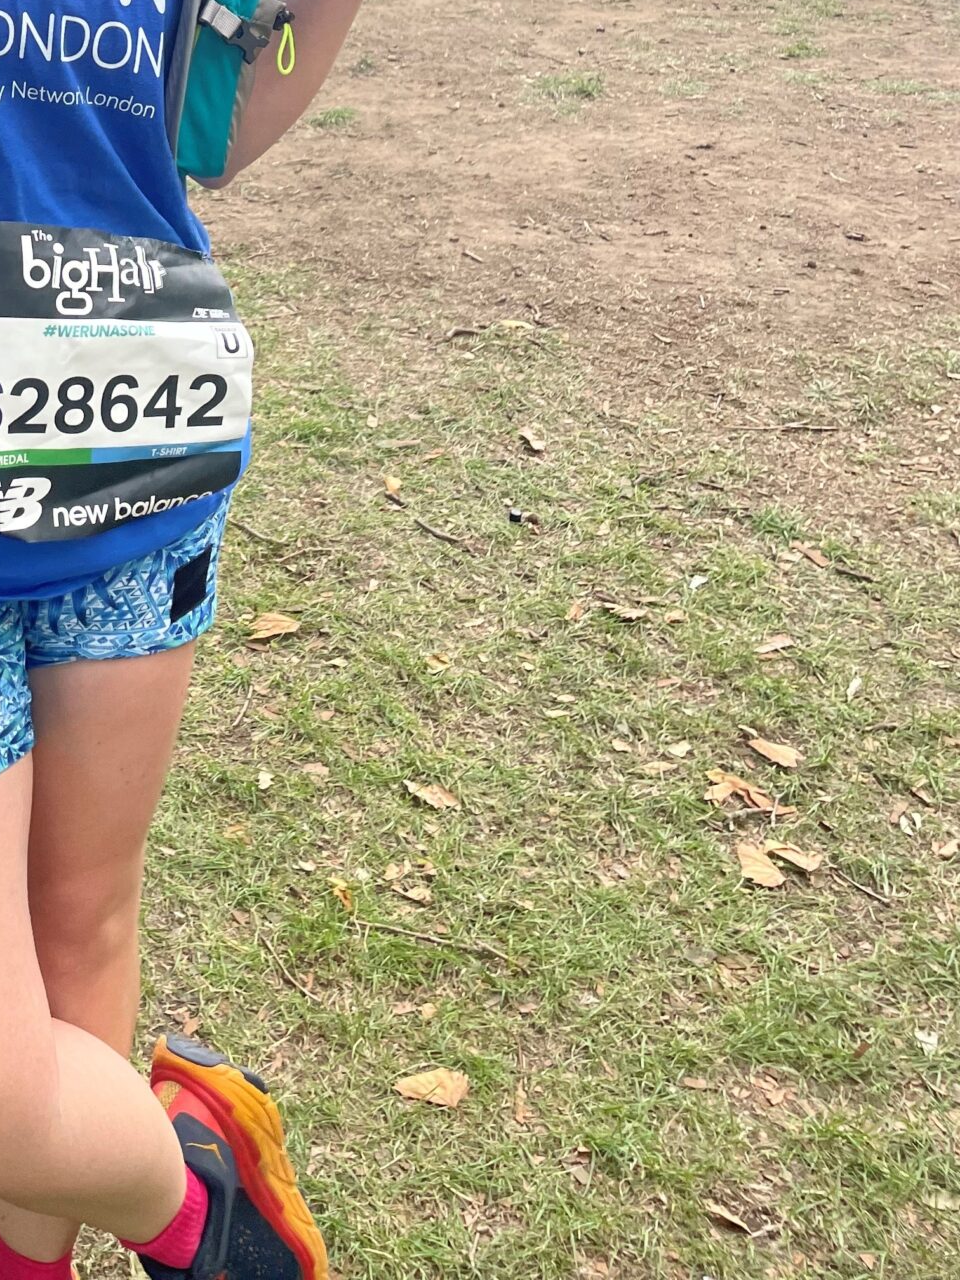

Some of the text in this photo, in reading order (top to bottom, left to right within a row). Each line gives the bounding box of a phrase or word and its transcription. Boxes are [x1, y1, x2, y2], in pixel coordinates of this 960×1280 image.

[85, 86, 155, 118] London
[31, 230, 53, 242] The
[43, 324, 156, 338] #WERUNASONE
[221, 332, 240, 354] U
[151, 446, 188, 456] T-SHIRT
[52, 503, 108, 527] new
